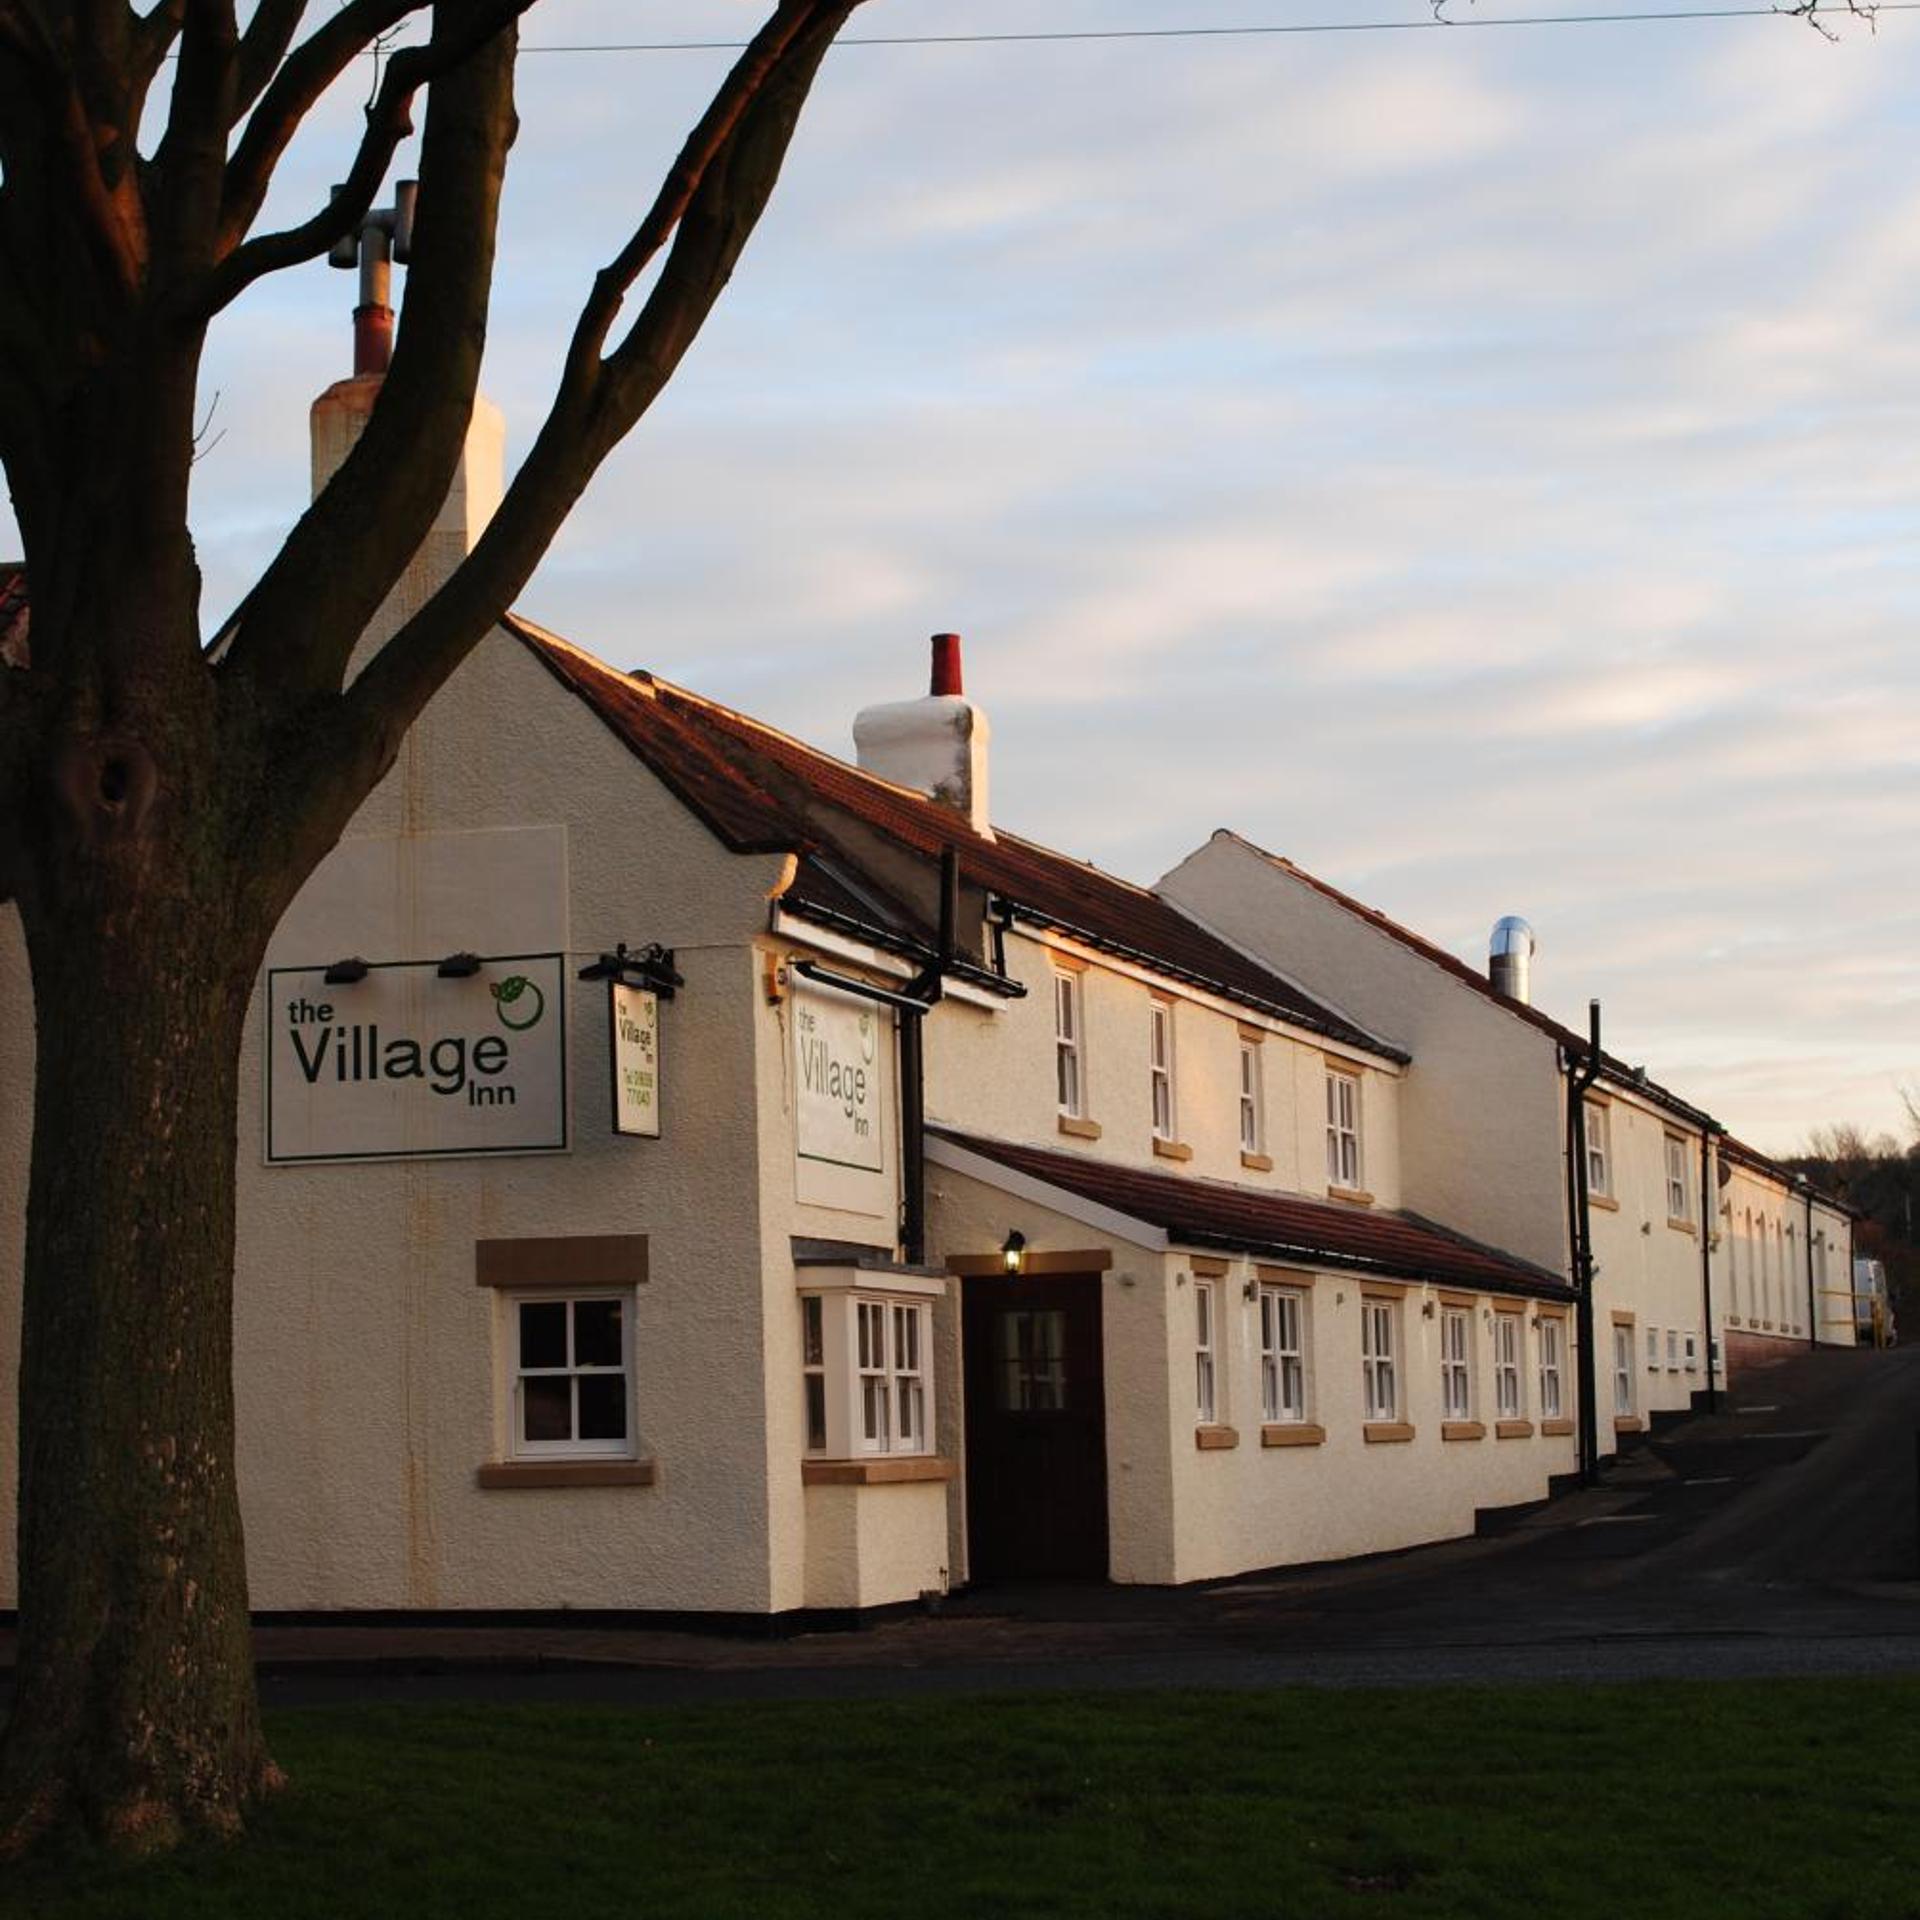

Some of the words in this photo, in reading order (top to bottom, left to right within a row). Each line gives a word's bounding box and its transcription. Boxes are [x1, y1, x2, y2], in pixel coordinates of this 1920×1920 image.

[287, 998, 334, 1024] the
[799, 1007, 815, 1033] the
[619, 1018, 652, 1051] Village
[291, 1025, 508, 1095] Village
[801, 1036, 865, 1118] Village
[468, 1079, 516, 1106] Inn
[855, 1111, 869, 1136] Inn
